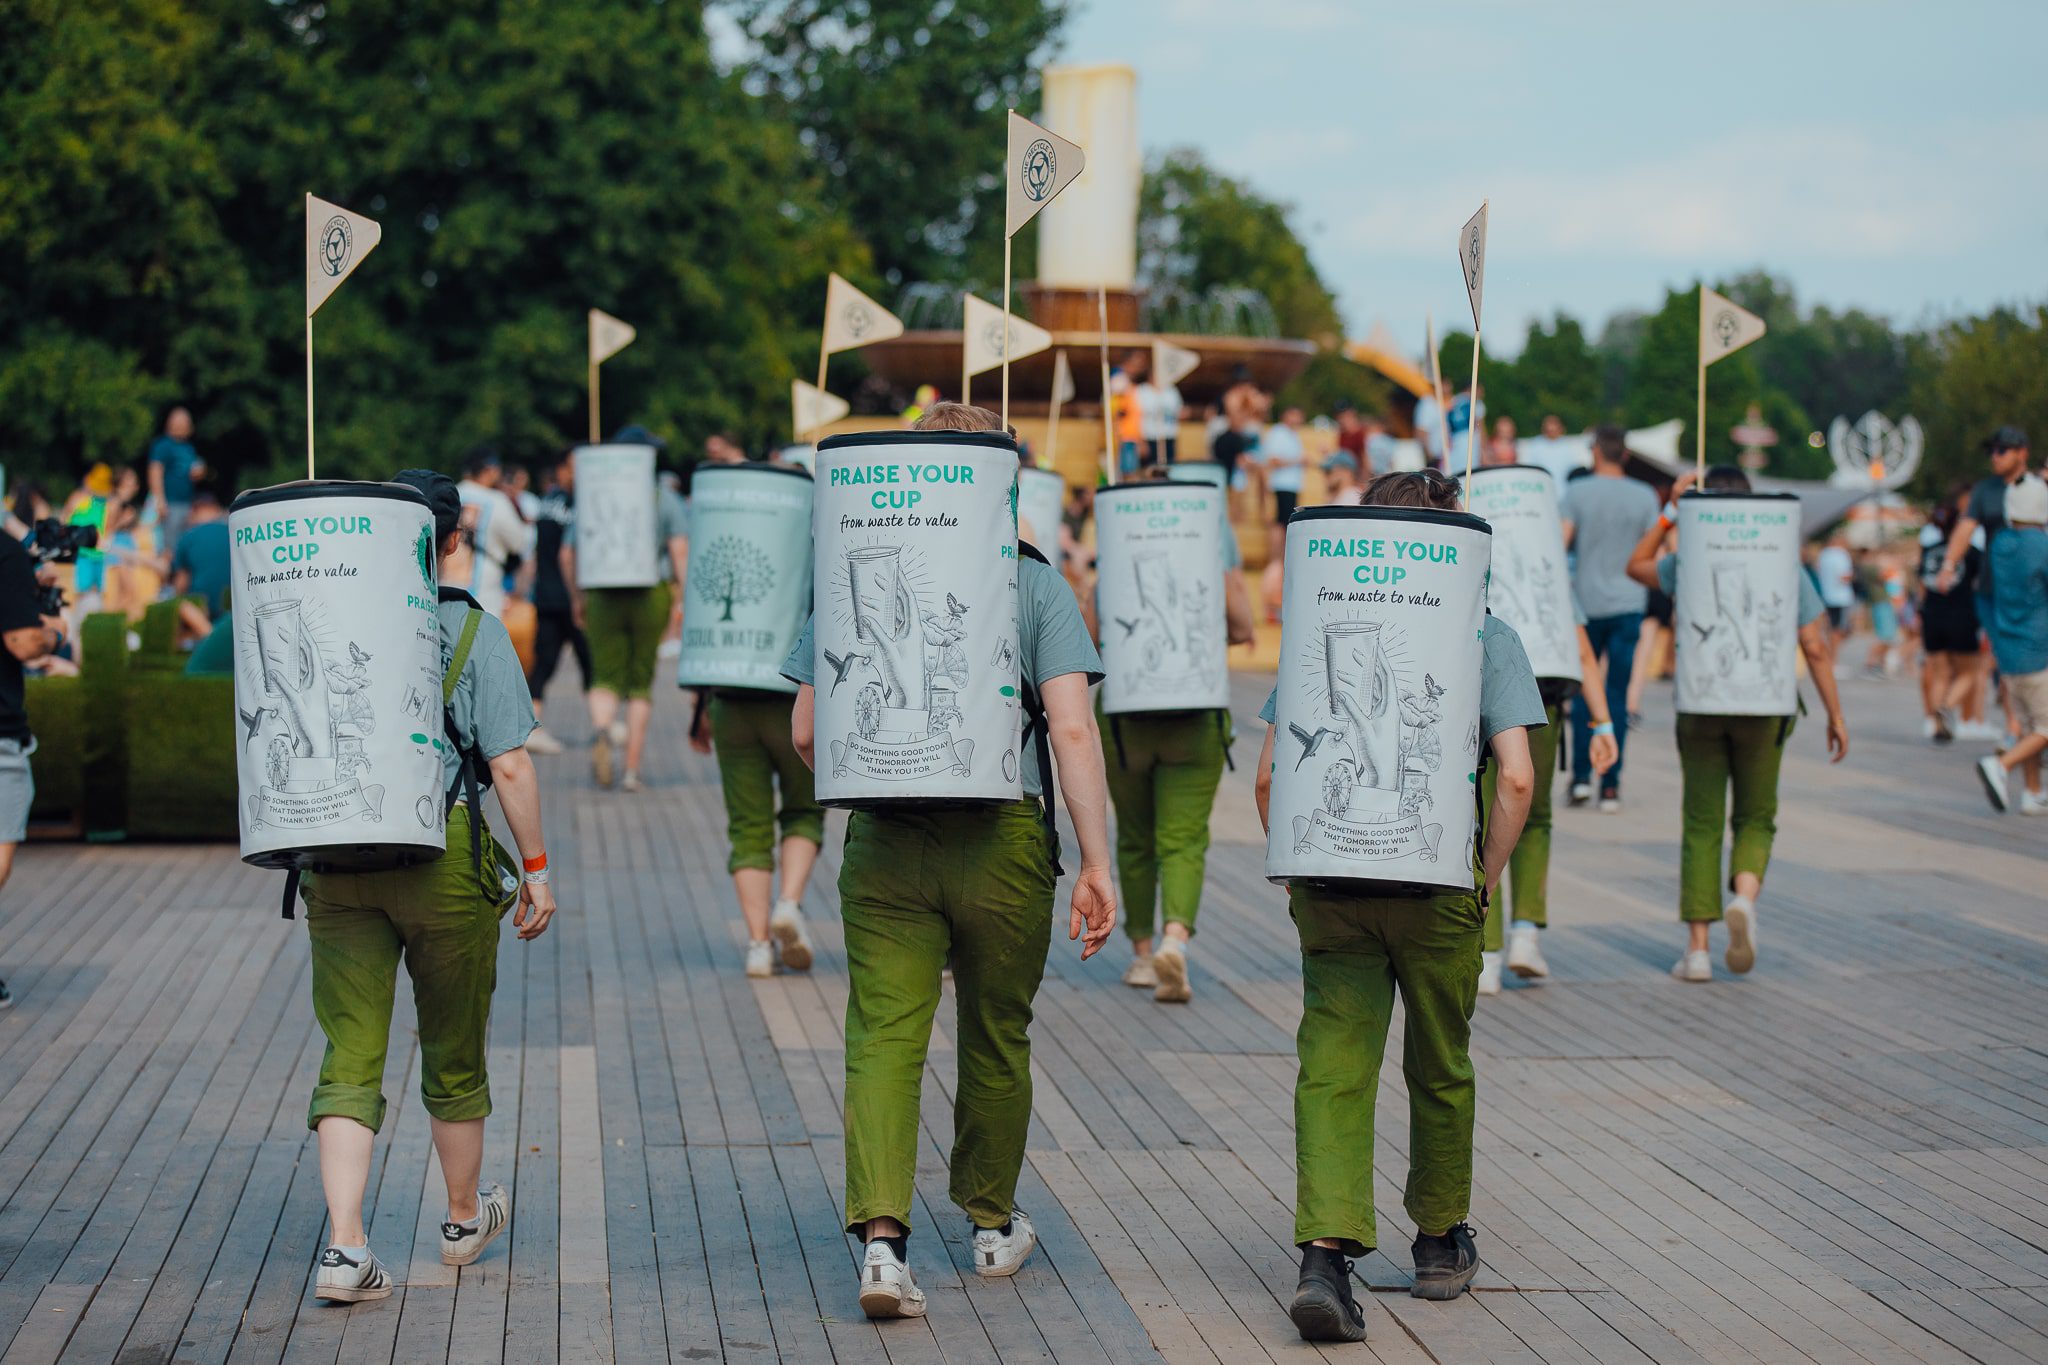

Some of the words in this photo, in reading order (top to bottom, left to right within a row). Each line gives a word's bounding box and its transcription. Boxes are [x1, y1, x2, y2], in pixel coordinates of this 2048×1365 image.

[1028, 142, 1049, 159] RECYCLE
[325, 219, 346, 236] RECYCLE
[831, 465, 900, 487] PRAISE
[906, 464, 975, 484] YOUR
[871, 490, 922, 509] CUP
[236, 519, 298, 547] PRAISE
[304, 516, 373, 536] YOUR
[840, 514, 865, 533] from
[867, 514, 904, 528] waste
[908, 513, 921, 527] to
[925, 512, 959, 527] value
[272, 543, 320, 564] CUP
[1308, 539, 1386, 558] PRAISE
[1393, 540, 1459, 565] YOUR
[247, 572, 267, 591] from
[270, 567, 304, 583] waste
[307, 565, 320, 578] to
[324, 563, 358, 577] value
[1353, 565, 1407, 585] CUP
[1317, 586, 1345, 605] from
[1349, 589, 1387, 603] waste
[1391, 590, 1404, 604] to
[1408, 591, 1441, 607] value
[850, 742, 859, 750] DO
[860, 745, 899, 757] SOMETHING
[901, 748, 924, 757] GOOD
[925, 741, 949, 753] TODAY
[857, 754, 874, 763] THAT
[875, 758, 920, 766] TOMORROW
[921, 753, 941, 763] WILL
[867, 766, 892, 775] THANK
[913, 765, 930, 774] FOR
[262, 794, 271, 803] DO
[272, 797, 309, 806] SOMETHING
[311, 795, 333, 805] GOOD
[334, 786, 357, 800] TODAY
[269, 805, 287, 815] THAT
[287, 805, 330, 815] TOMORROW
[330, 800, 350, 809] WILL
[279, 816, 304, 824] THANK
[305, 815, 322, 824] YOU
[323, 811, 341, 821] FOR
[1315, 818, 1326, 827] DO
[1327, 823, 1368, 837] SOMETHING
[1370, 829, 1394, 837] GOOD
[1395, 823, 1418, 835] TODAY
[1323, 831, 1341, 841] THAT
[1342, 836, 1389, 846] TOMORROW
[1390, 836, 1410, 844] WILL
[1333, 844, 1360, 854] THANK
[1382, 847, 1399, 855] FOR
